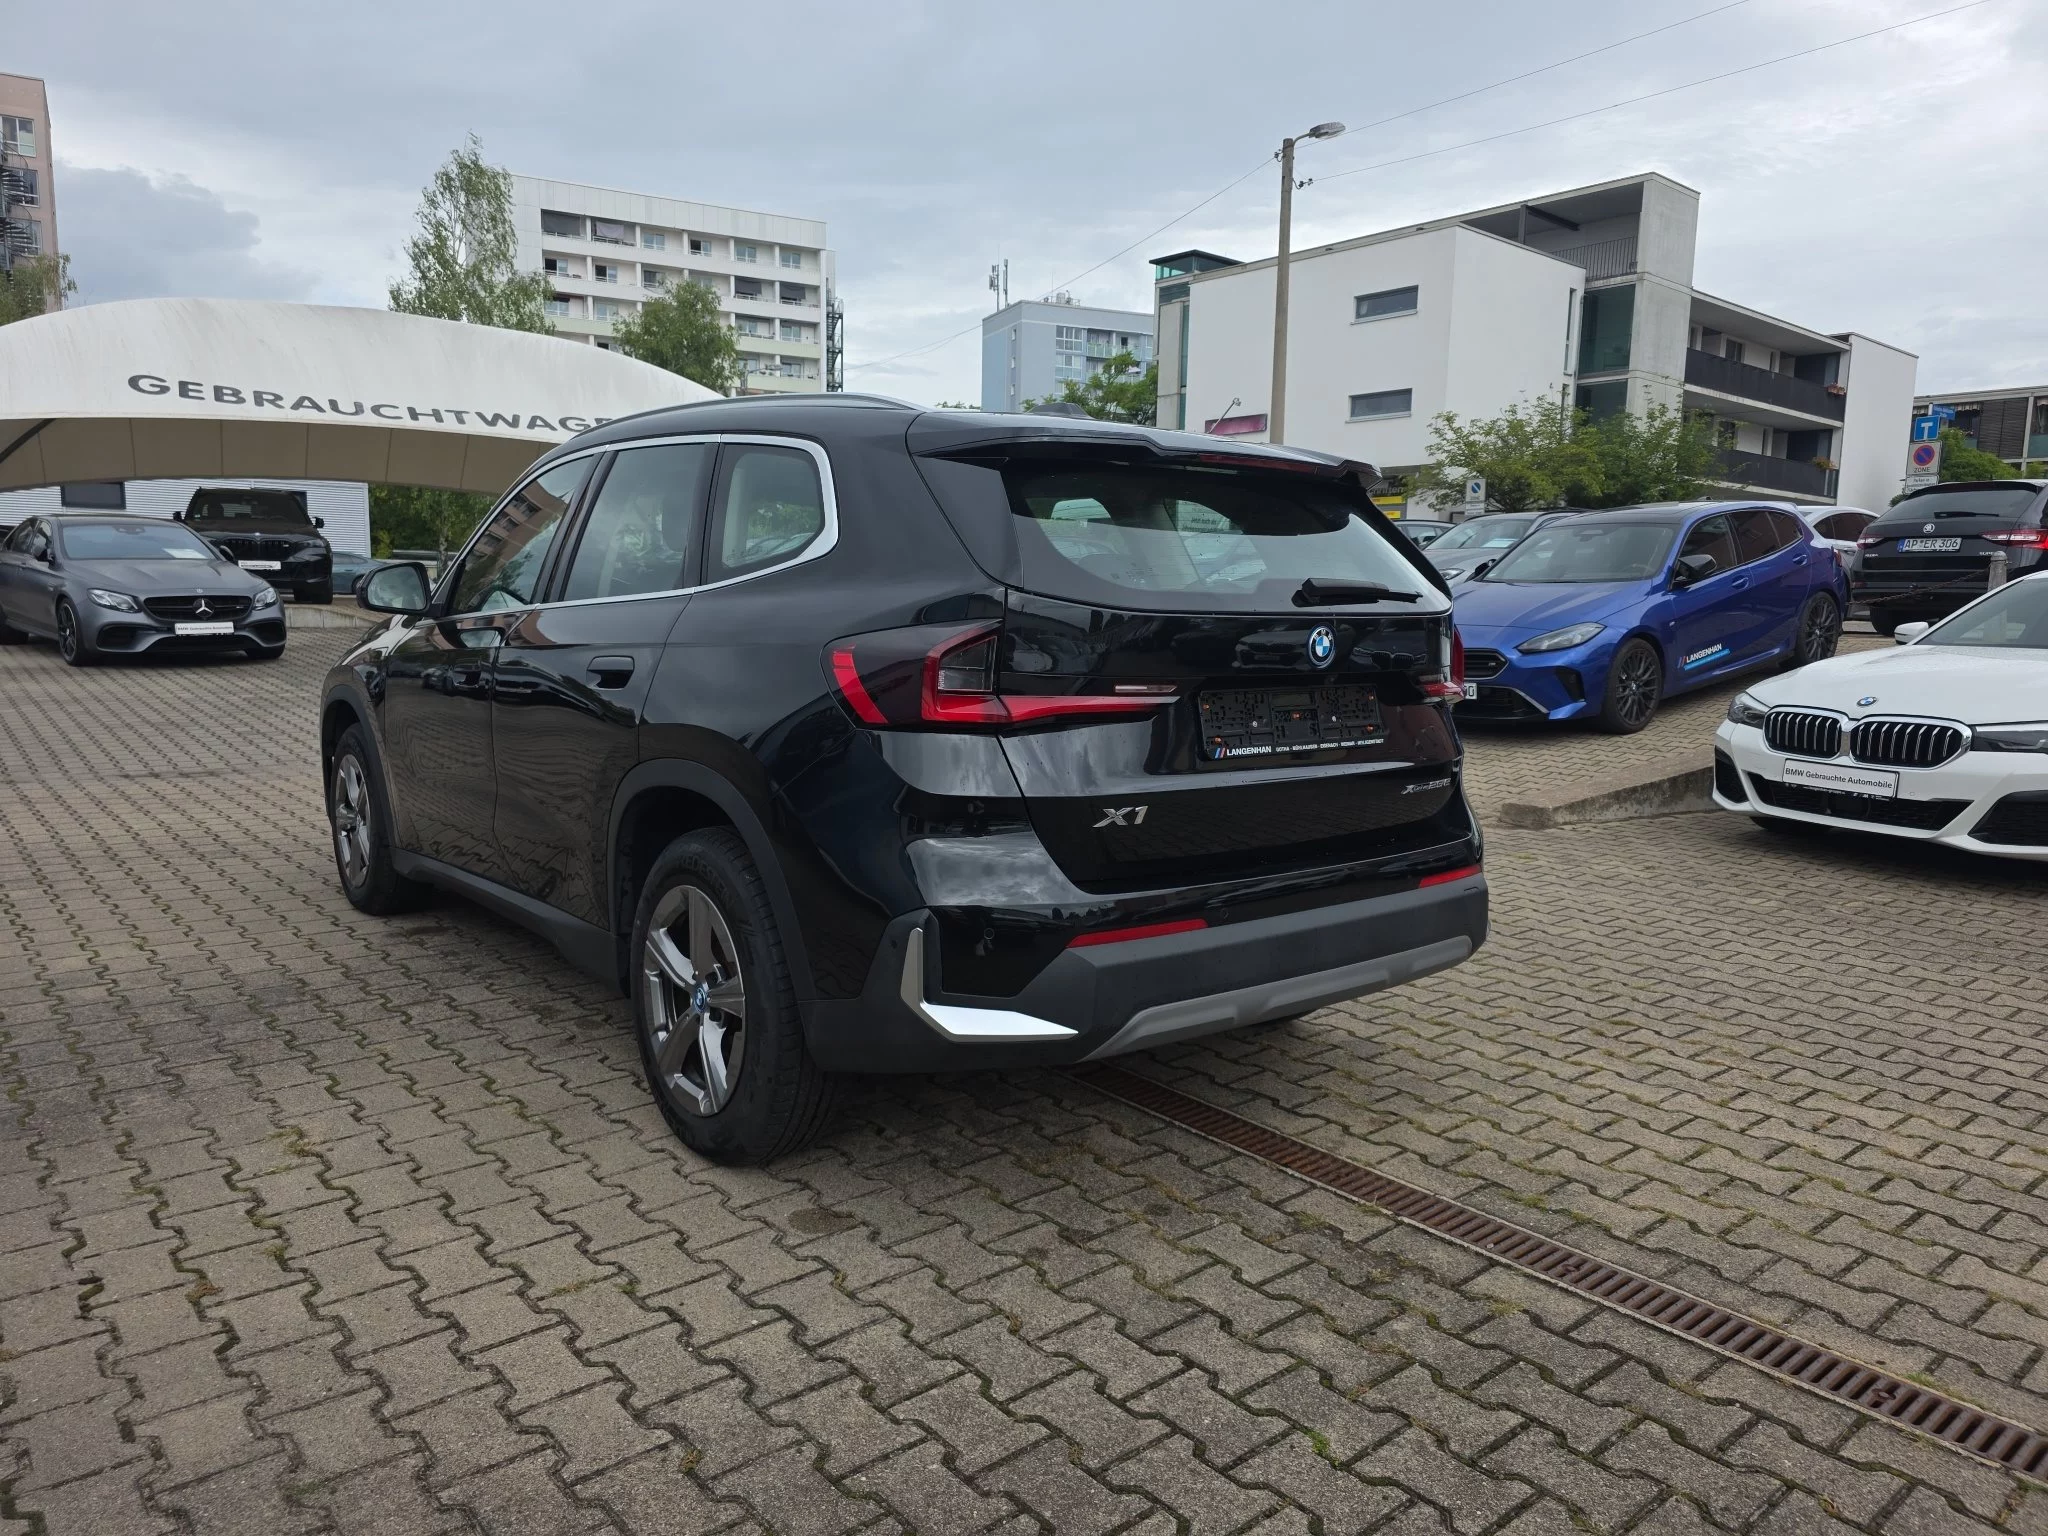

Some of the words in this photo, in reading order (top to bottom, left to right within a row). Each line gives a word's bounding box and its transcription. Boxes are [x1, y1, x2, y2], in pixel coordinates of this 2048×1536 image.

[1939, 538, 1959, 548] 306
[1687, 643, 1722, 663] LANGENHAN
[1226, 745, 1272, 756] LANGENHAN
[1785, 767, 1804, 777] BMW
[1806, 771, 1846, 783] Gebrauchte
[1848, 776, 1893, 789] Automobile
[1092, 805, 1149, 828] X1
